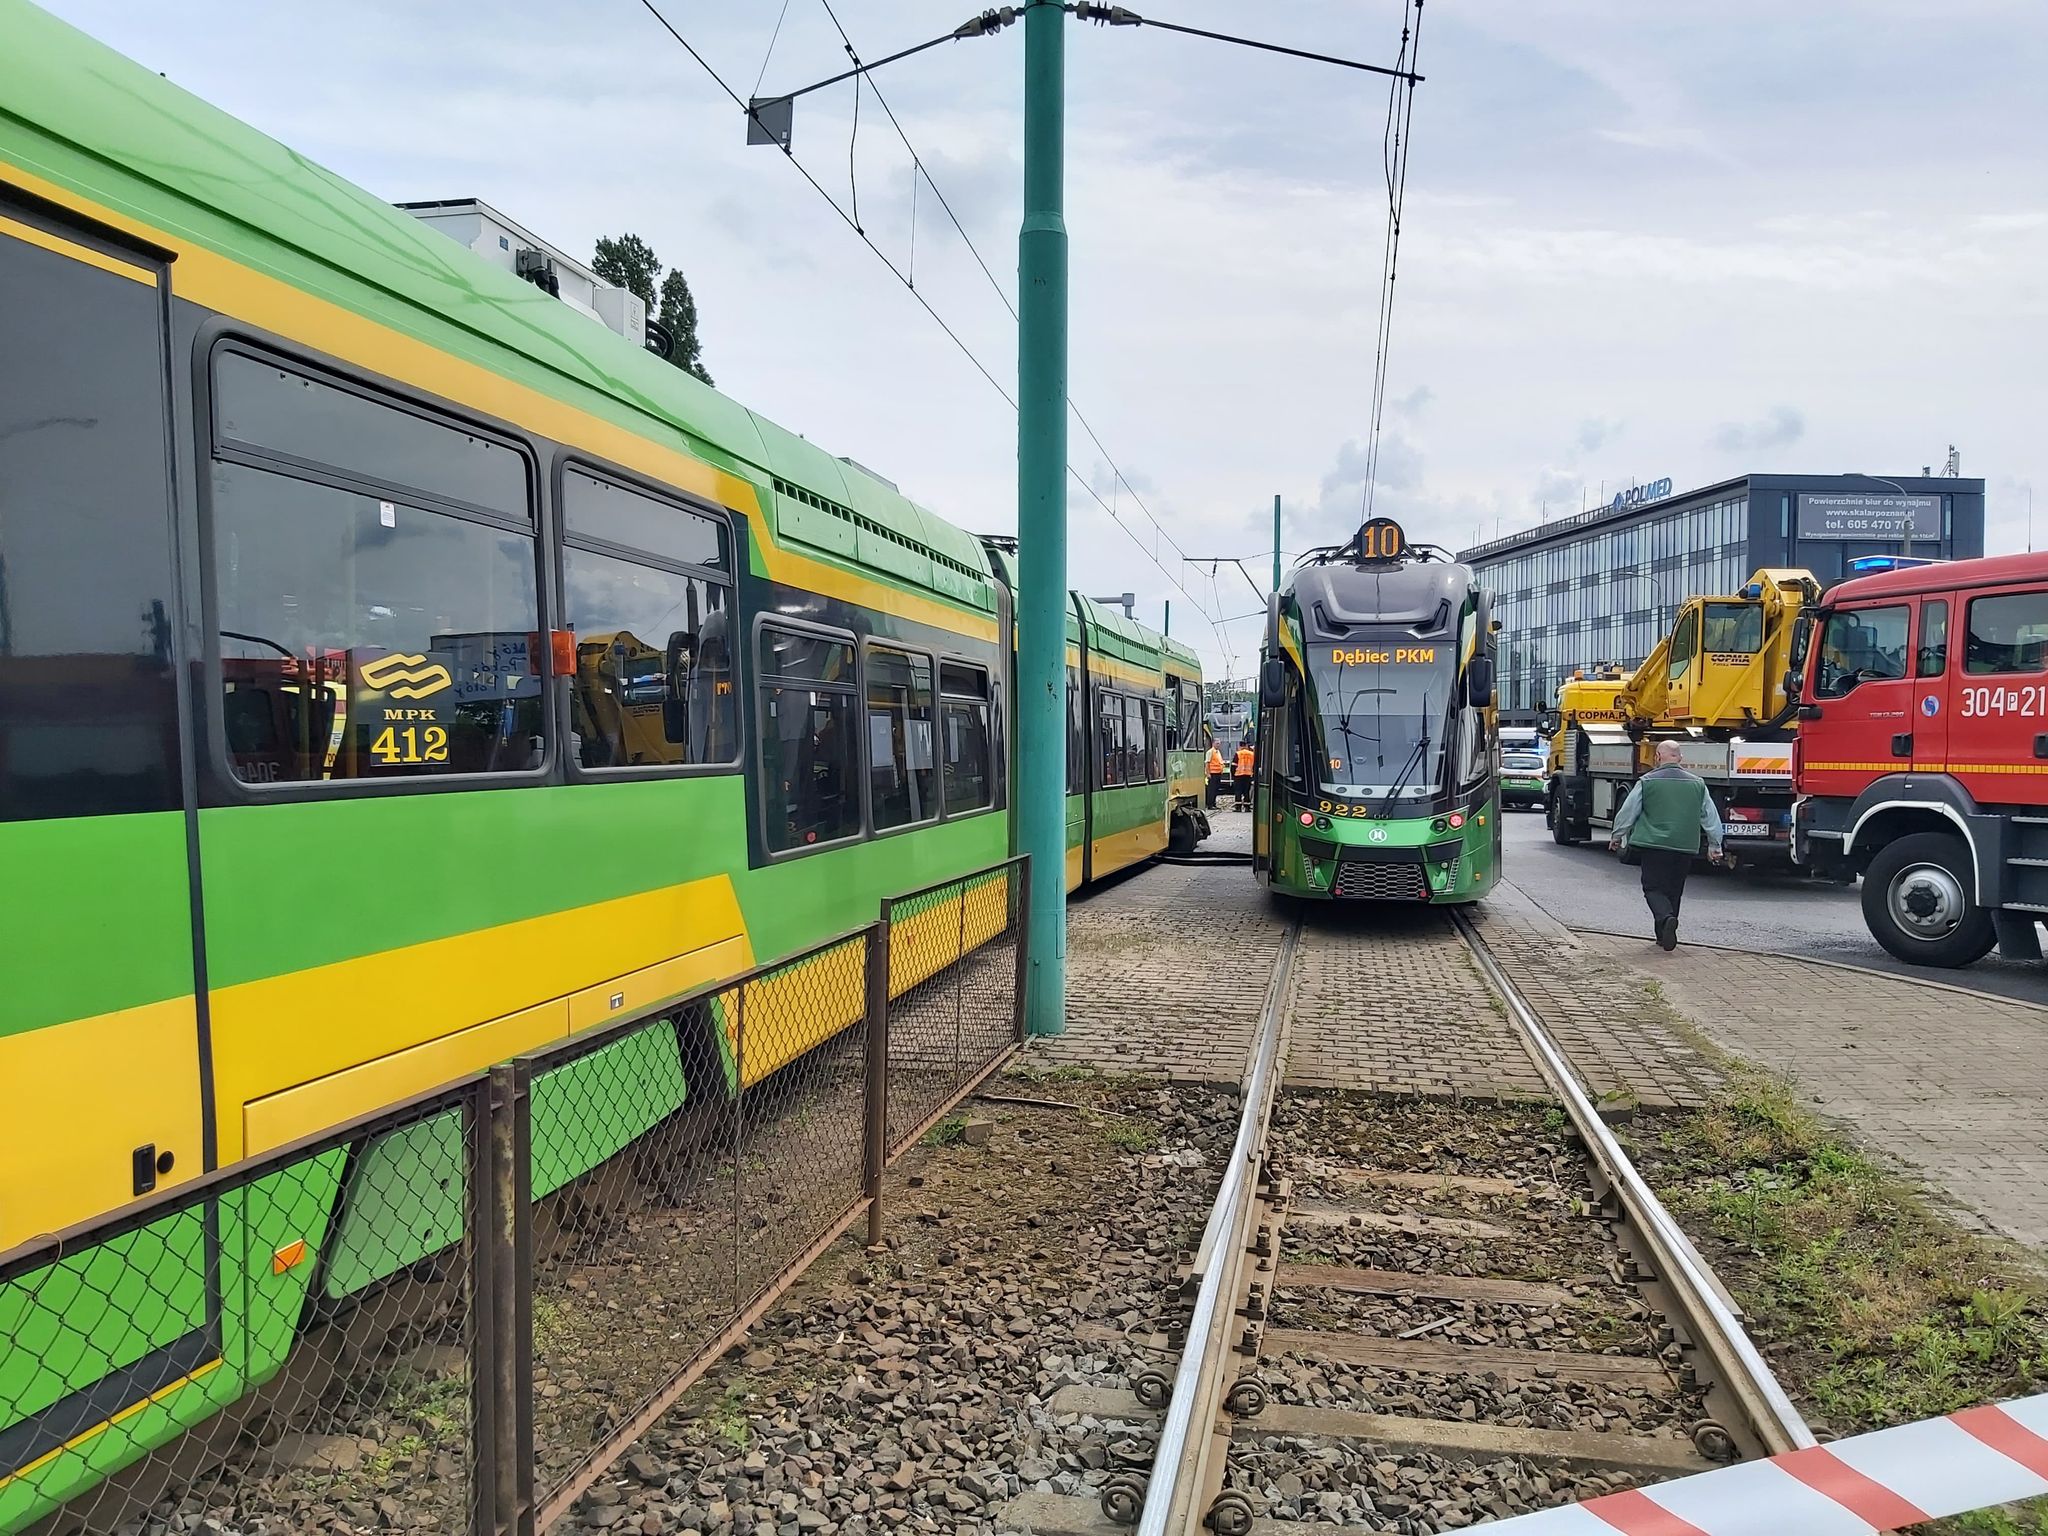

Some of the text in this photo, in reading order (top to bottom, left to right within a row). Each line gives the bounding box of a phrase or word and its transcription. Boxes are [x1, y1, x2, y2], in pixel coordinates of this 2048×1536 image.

[1625, 477, 1672, 503] POLMED
[1808, 497, 1931, 508] Powierzchnie biur do wynajmu
[1825, 508, 1915, 518] www.skalarpoznan.pl
[1825, 520, 1844, 529] tel.
[1847, 520, 1868, 530] 605
[1871, 520, 1892, 530] 470
[1364, 525, 1399, 558] 10
[1332, 649, 1434, 667] Dębiec PKM
[1711, 654, 1750, 663] COPMA
[383, 709, 436, 721] MPK
[1578, 711, 1627, 720] COPMA.P
[371, 726, 448, 764] 412
[1329, 759, 1341, 769] 10
[1320, 800, 1367, 817] 922
[1726, 824, 1767, 833] PO 9AP54
